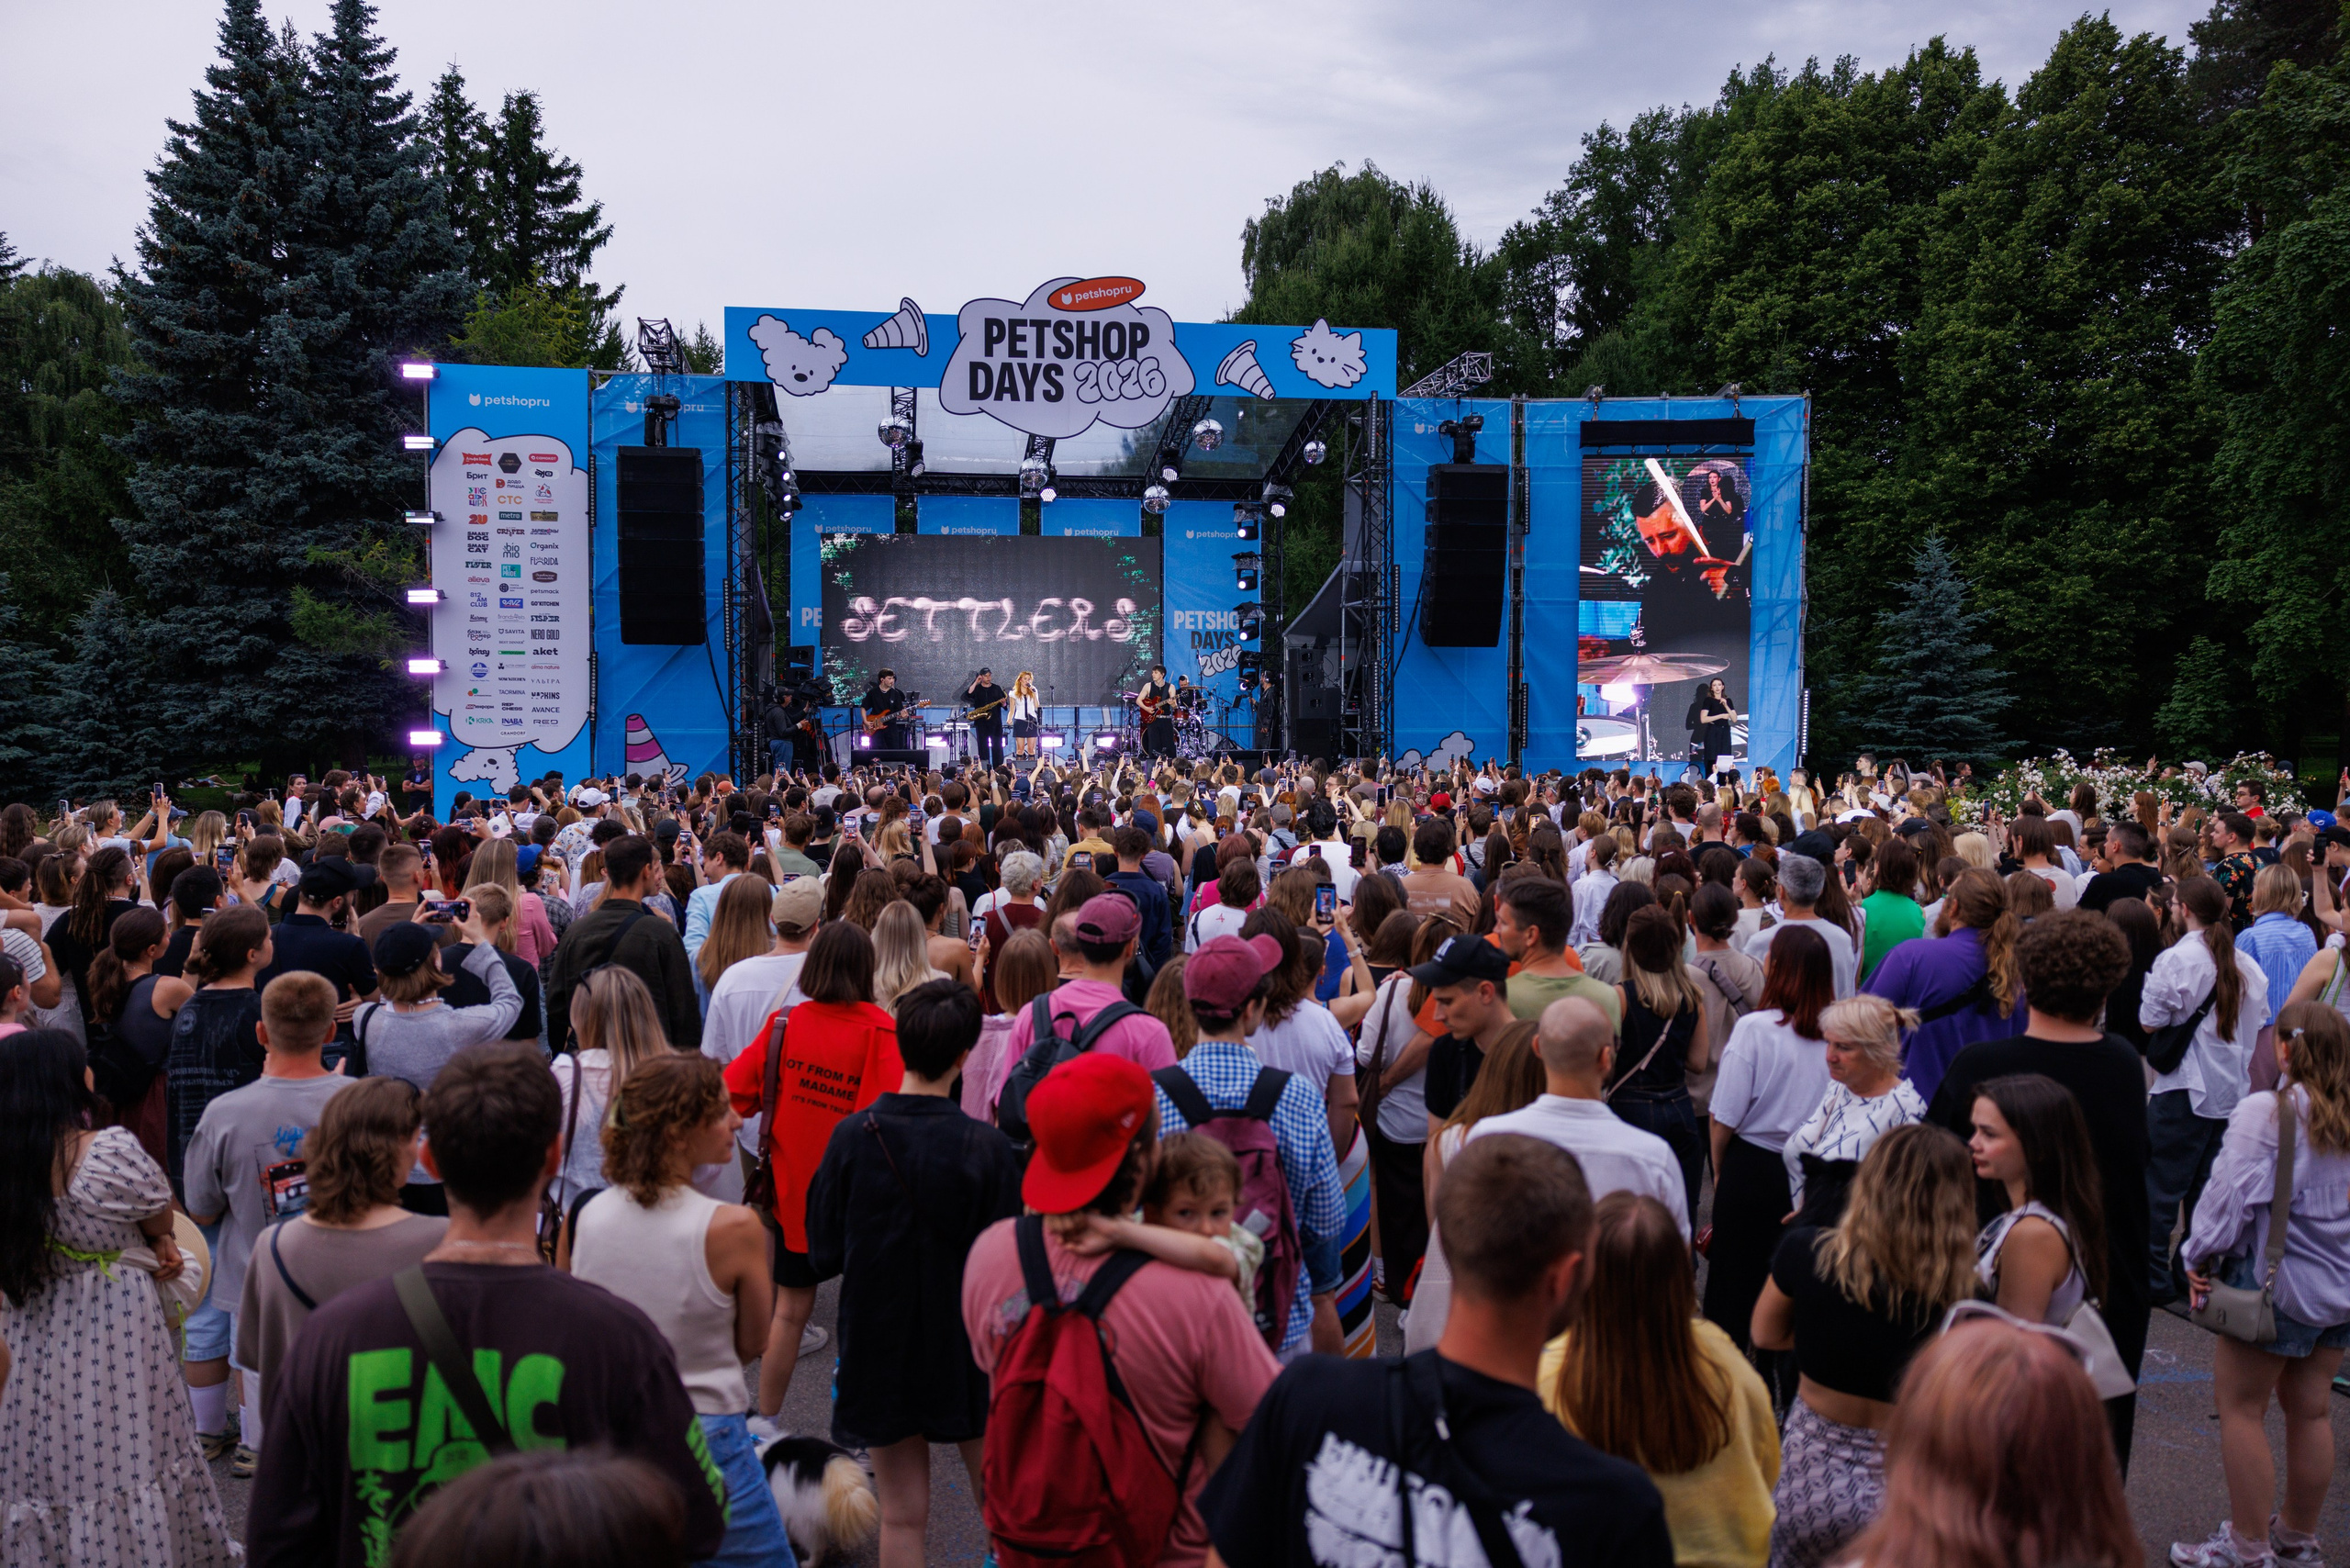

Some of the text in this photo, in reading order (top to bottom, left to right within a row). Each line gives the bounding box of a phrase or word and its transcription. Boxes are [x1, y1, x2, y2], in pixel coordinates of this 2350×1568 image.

[1075, 285, 1132, 303] petshopru
[984, 318, 1150, 361] PETSHOP
[969, 356, 1167, 404] DAYS 2026
[485, 395, 550, 409] petshopru
[466, 472, 488, 480] Брит
[825, 524, 872, 533] petshopru
[951, 526, 997, 535] petshopru
[1074, 528, 1119, 536] petshopru
[531, 543, 559, 551] Organix
[465, 561, 492, 569] FLYER
[840, 596, 1137, 643] SETTLERS
[1173, 610, 1239, 631] PETSHO
[531, 629, 560, 640] NERO GOLD
[1191, 631, 1236, 649] DAYS
[532, 647, 558, 655] aket
[786, 1058, 804, 1071] OT
[807, 1064, 844, 1082] FROM
[799, 1078, 855, 1102] MADAME
